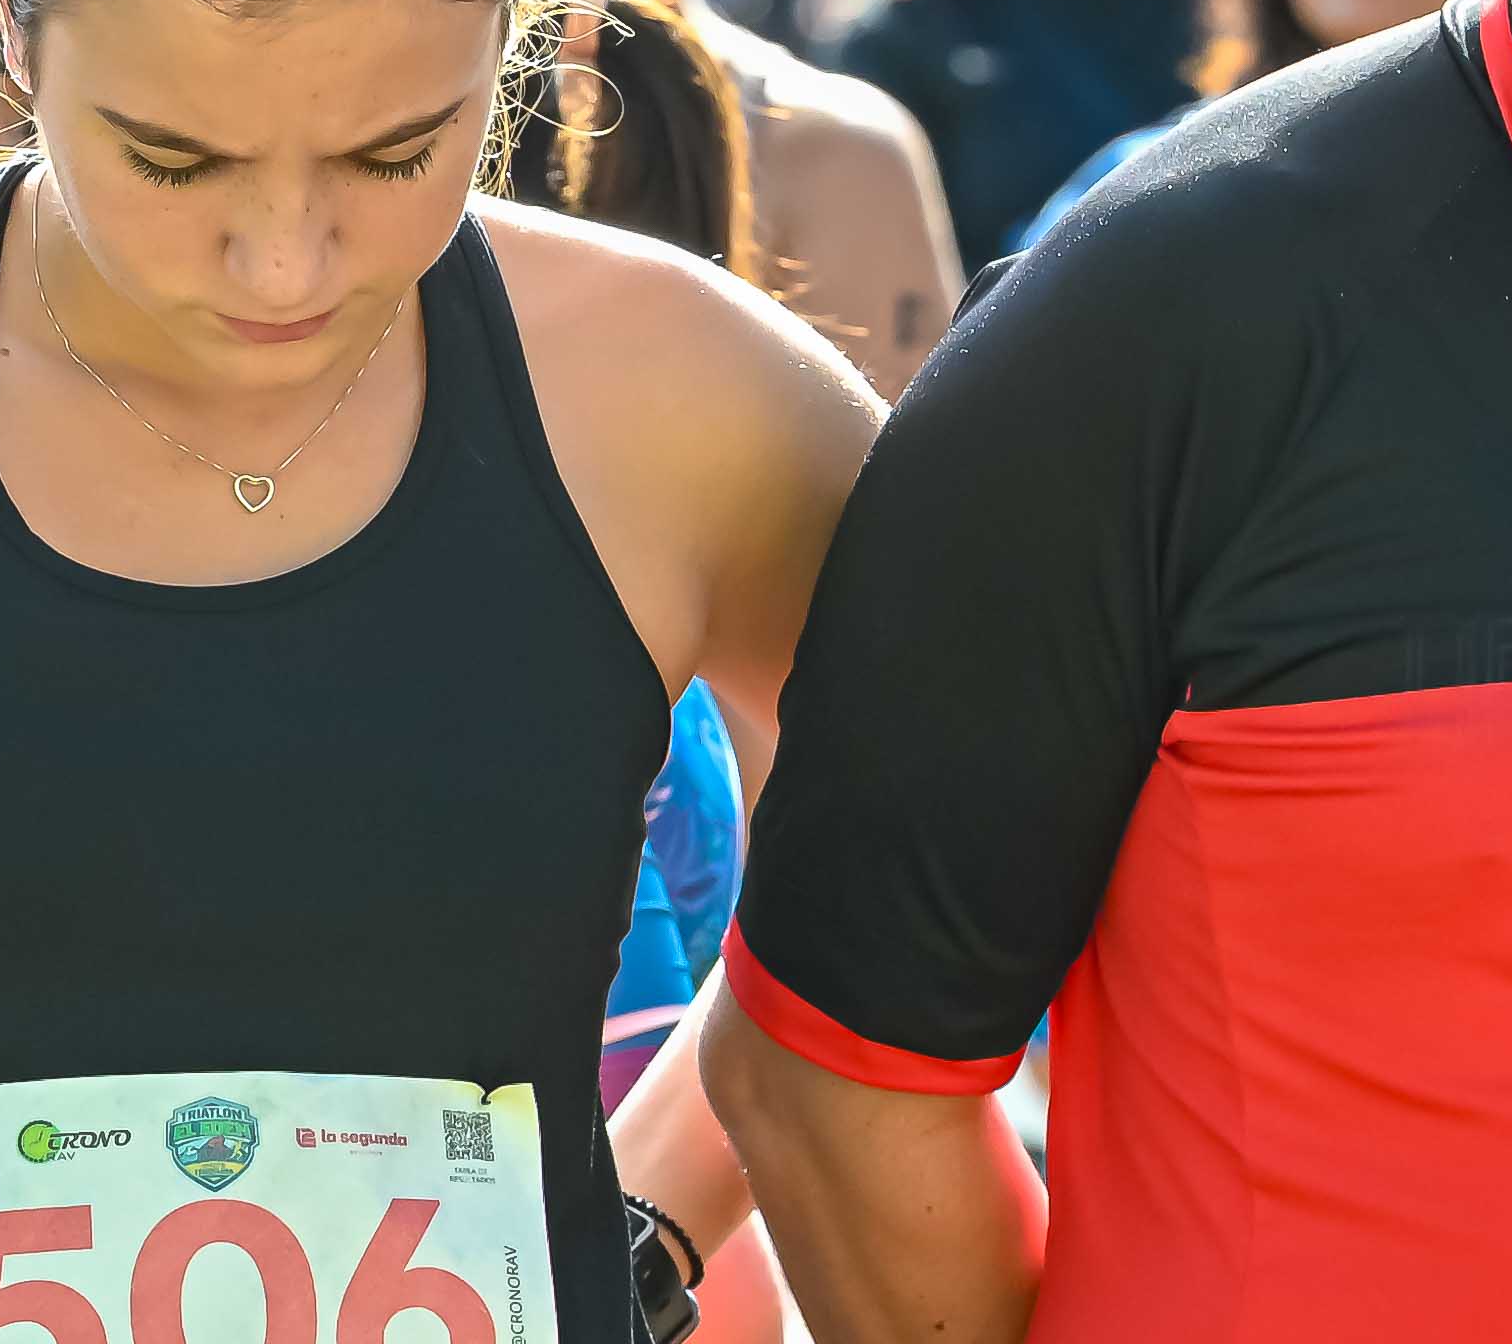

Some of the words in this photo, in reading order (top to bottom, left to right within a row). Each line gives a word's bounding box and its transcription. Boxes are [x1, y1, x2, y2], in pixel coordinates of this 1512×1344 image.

[179, 1106, 244, 1122] TRIATLON
[47, 1129, 132, 1150] CRONO
[321, 1128, 337, 1143] la
[340, 1131, 408, 1147] segunda
